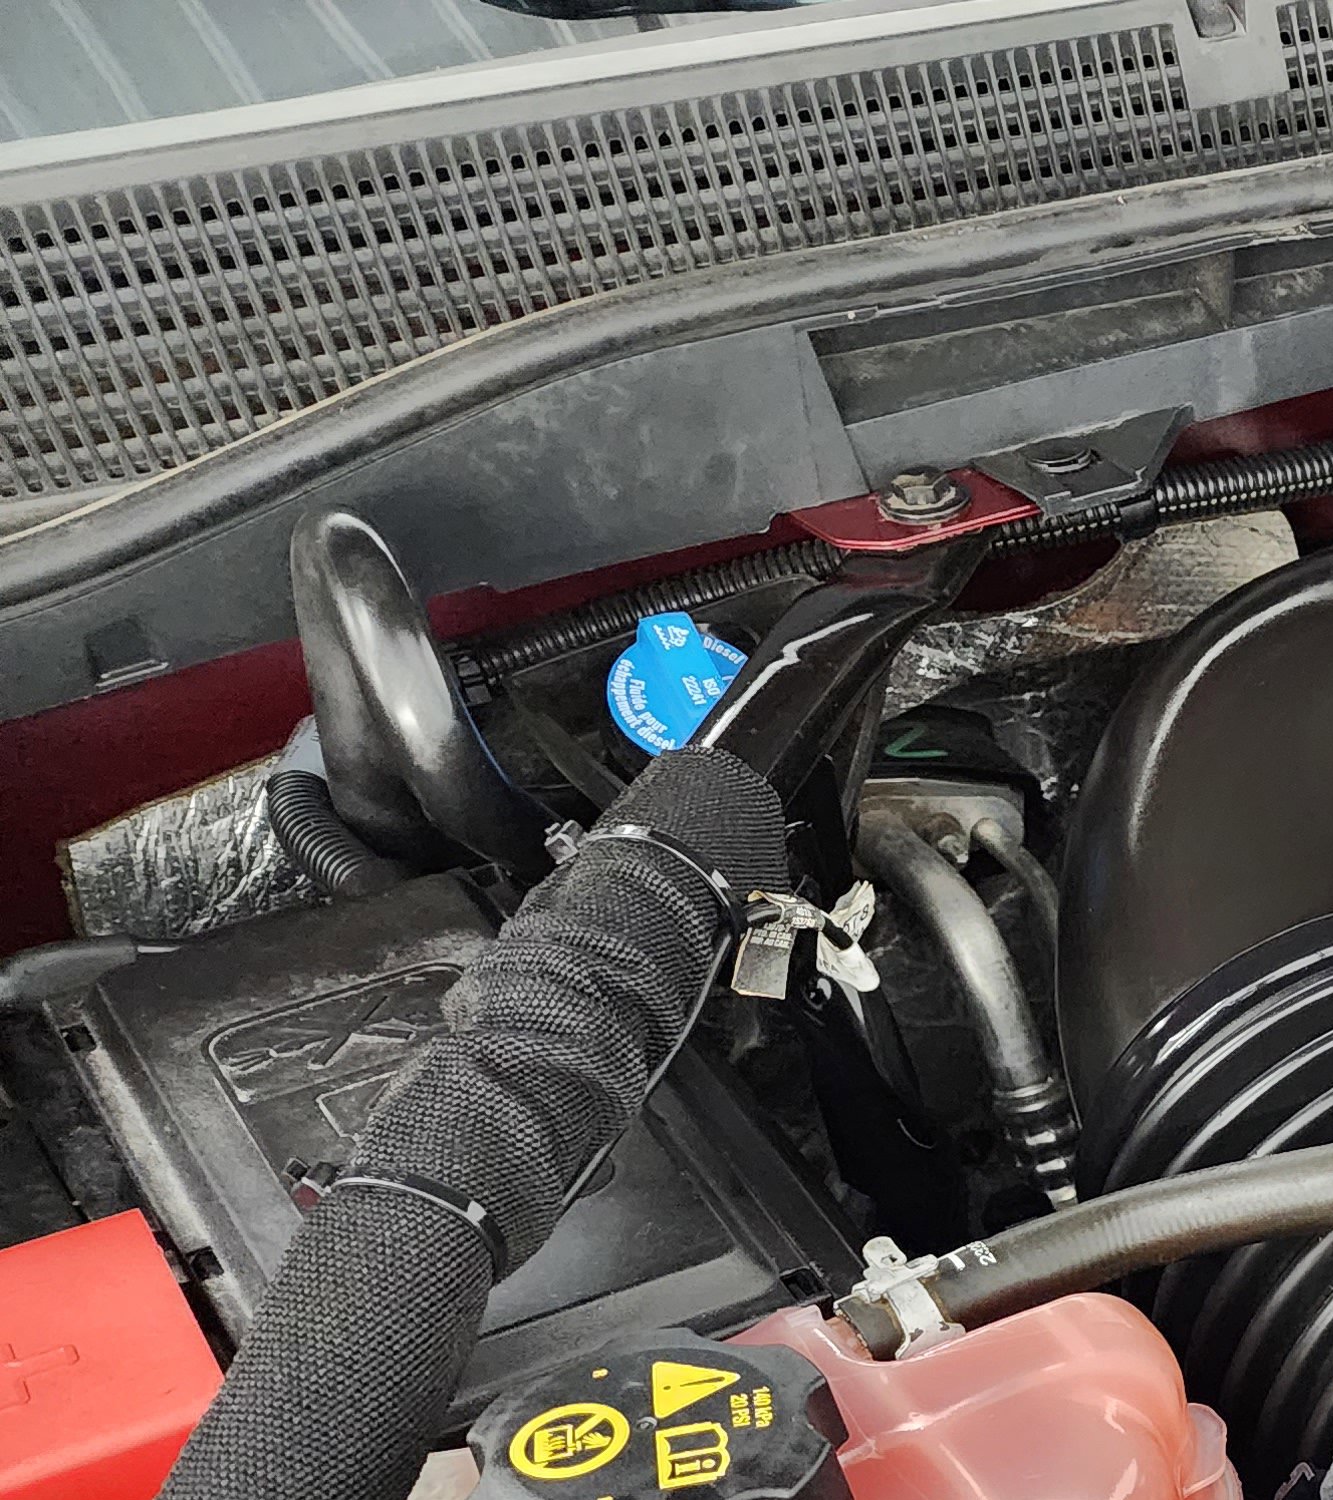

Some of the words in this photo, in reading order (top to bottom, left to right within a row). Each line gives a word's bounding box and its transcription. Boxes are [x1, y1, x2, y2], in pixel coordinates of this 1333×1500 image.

[629, 678, 649, 711] Fluide
[702, 678, 721, 697] ISO
[638, 711, 668, 734] pour
[730, 1393, 749, 1408] 20
[752, 1386, 772, 1407] 140
[731, 1408, 751, 1427] PSI
[754, 1407, 774, 1428] kPa
